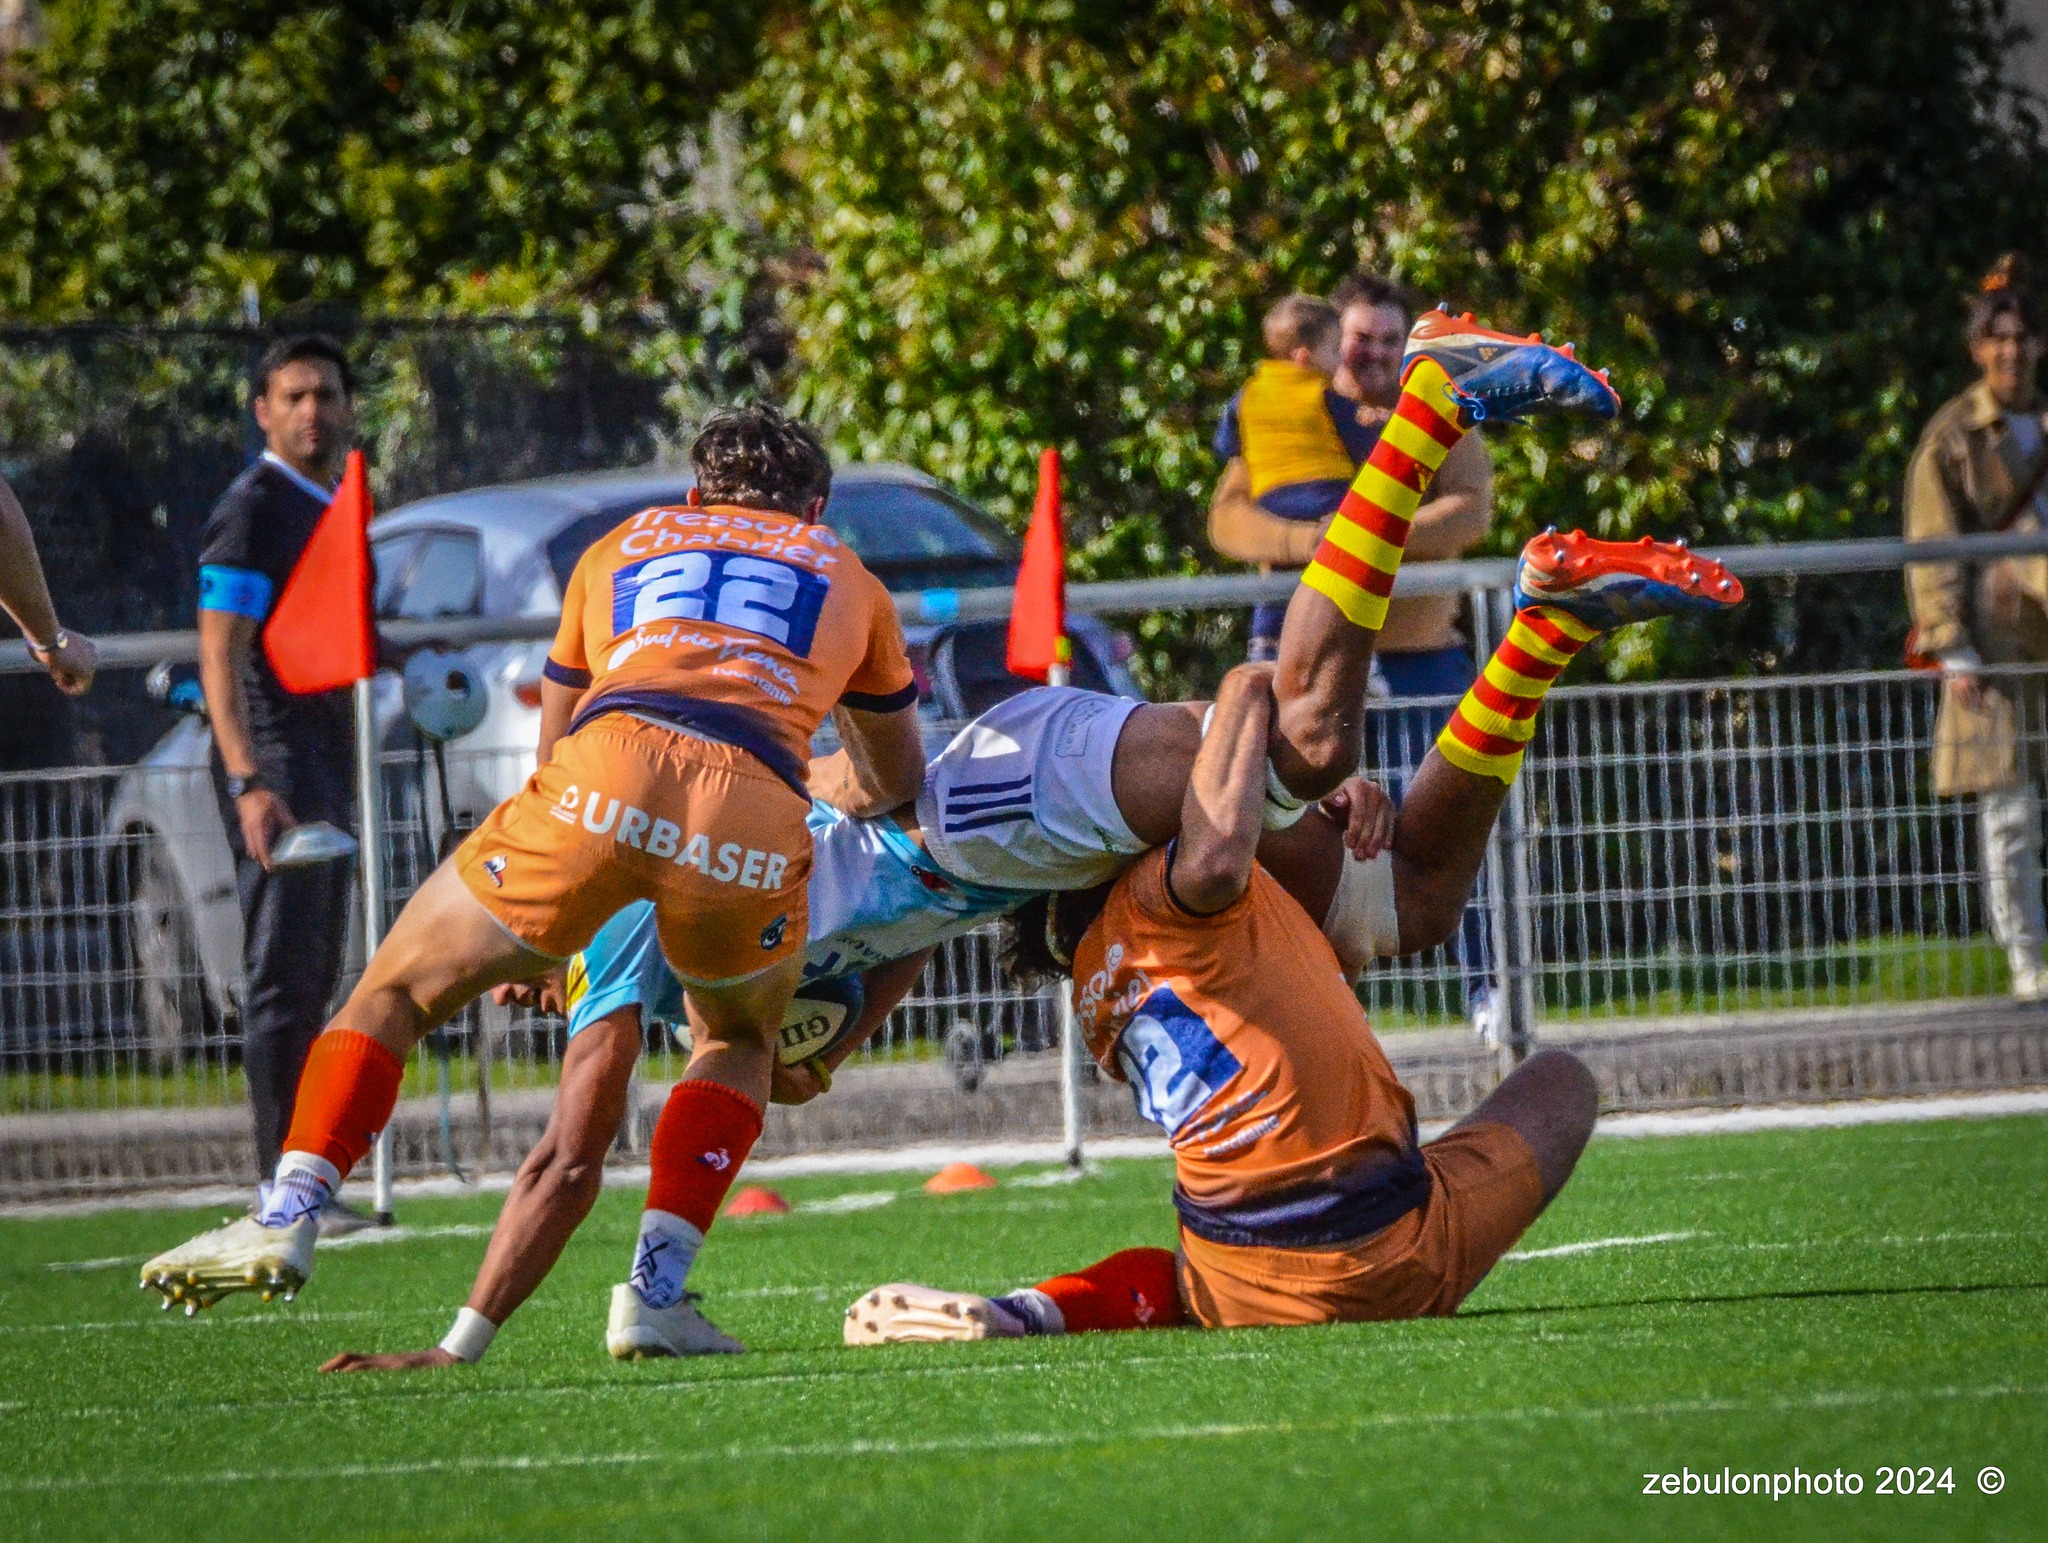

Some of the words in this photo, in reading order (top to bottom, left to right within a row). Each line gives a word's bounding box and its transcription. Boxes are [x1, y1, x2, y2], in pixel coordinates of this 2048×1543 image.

[621, 528, 839, 568] Chabrier
[633, 551, 799, 645] 22
[582, 791, 789, 890] URBASER
